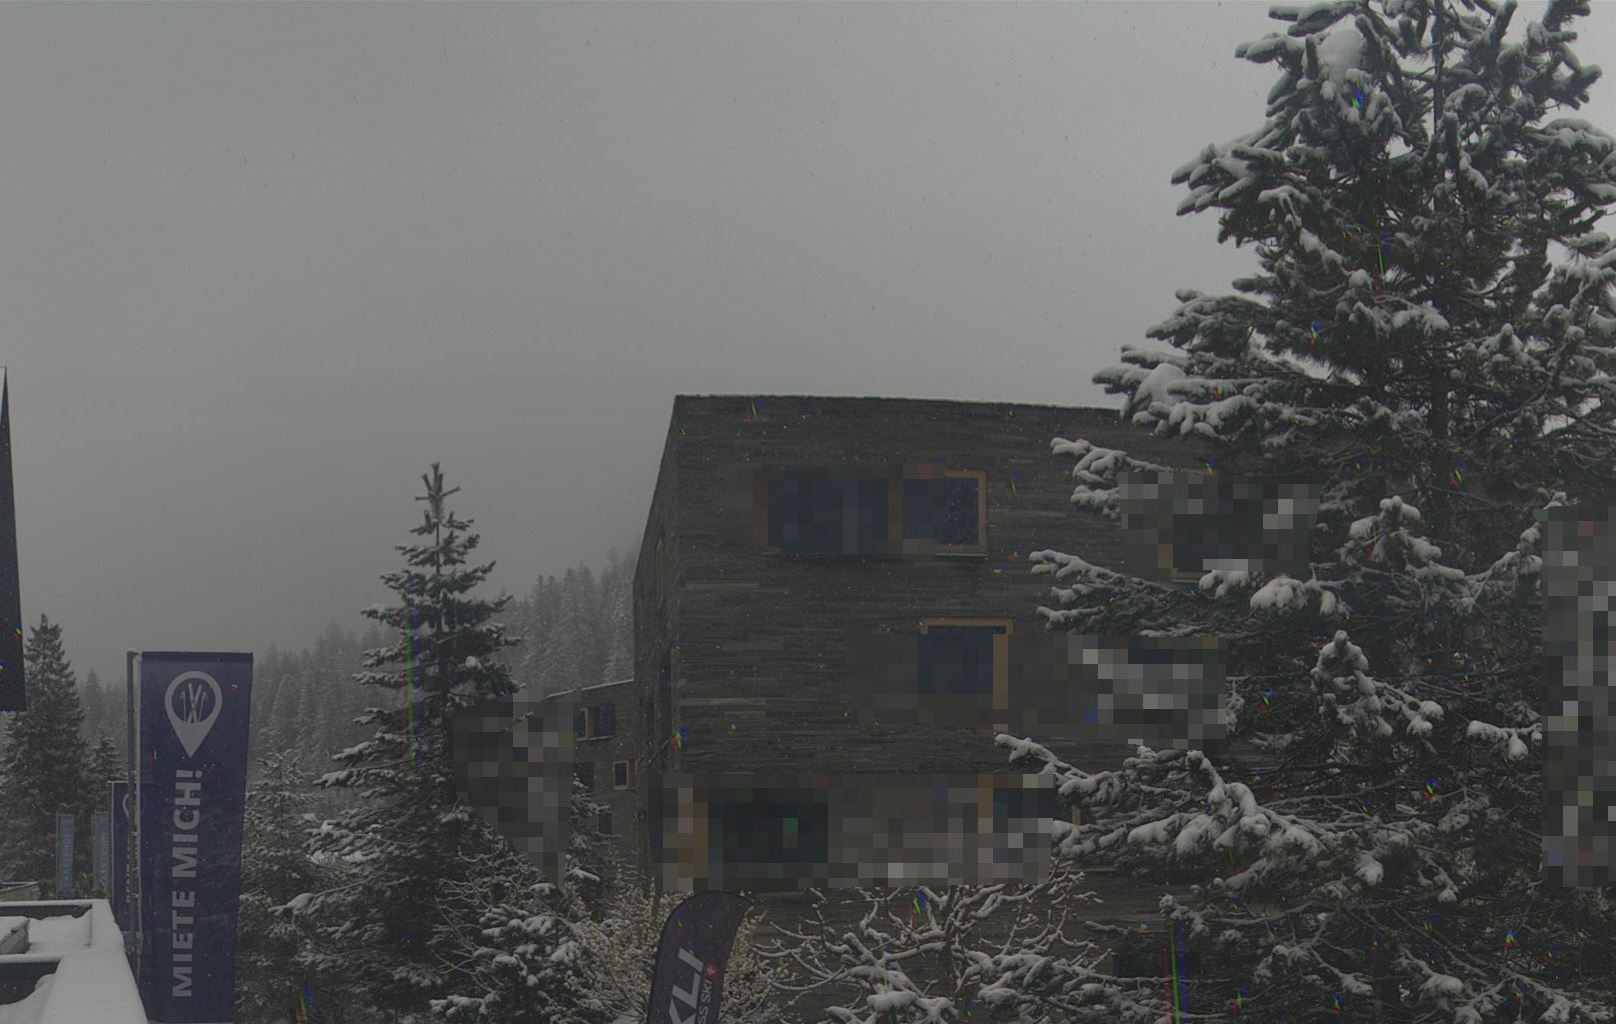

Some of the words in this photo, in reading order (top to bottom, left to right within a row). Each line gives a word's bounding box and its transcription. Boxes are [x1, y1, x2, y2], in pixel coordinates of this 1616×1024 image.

[172, 768, 203, 878] MICH!
[171, 889, 197, 998] MIETE
[701, 979, 713, 1004] SKI
